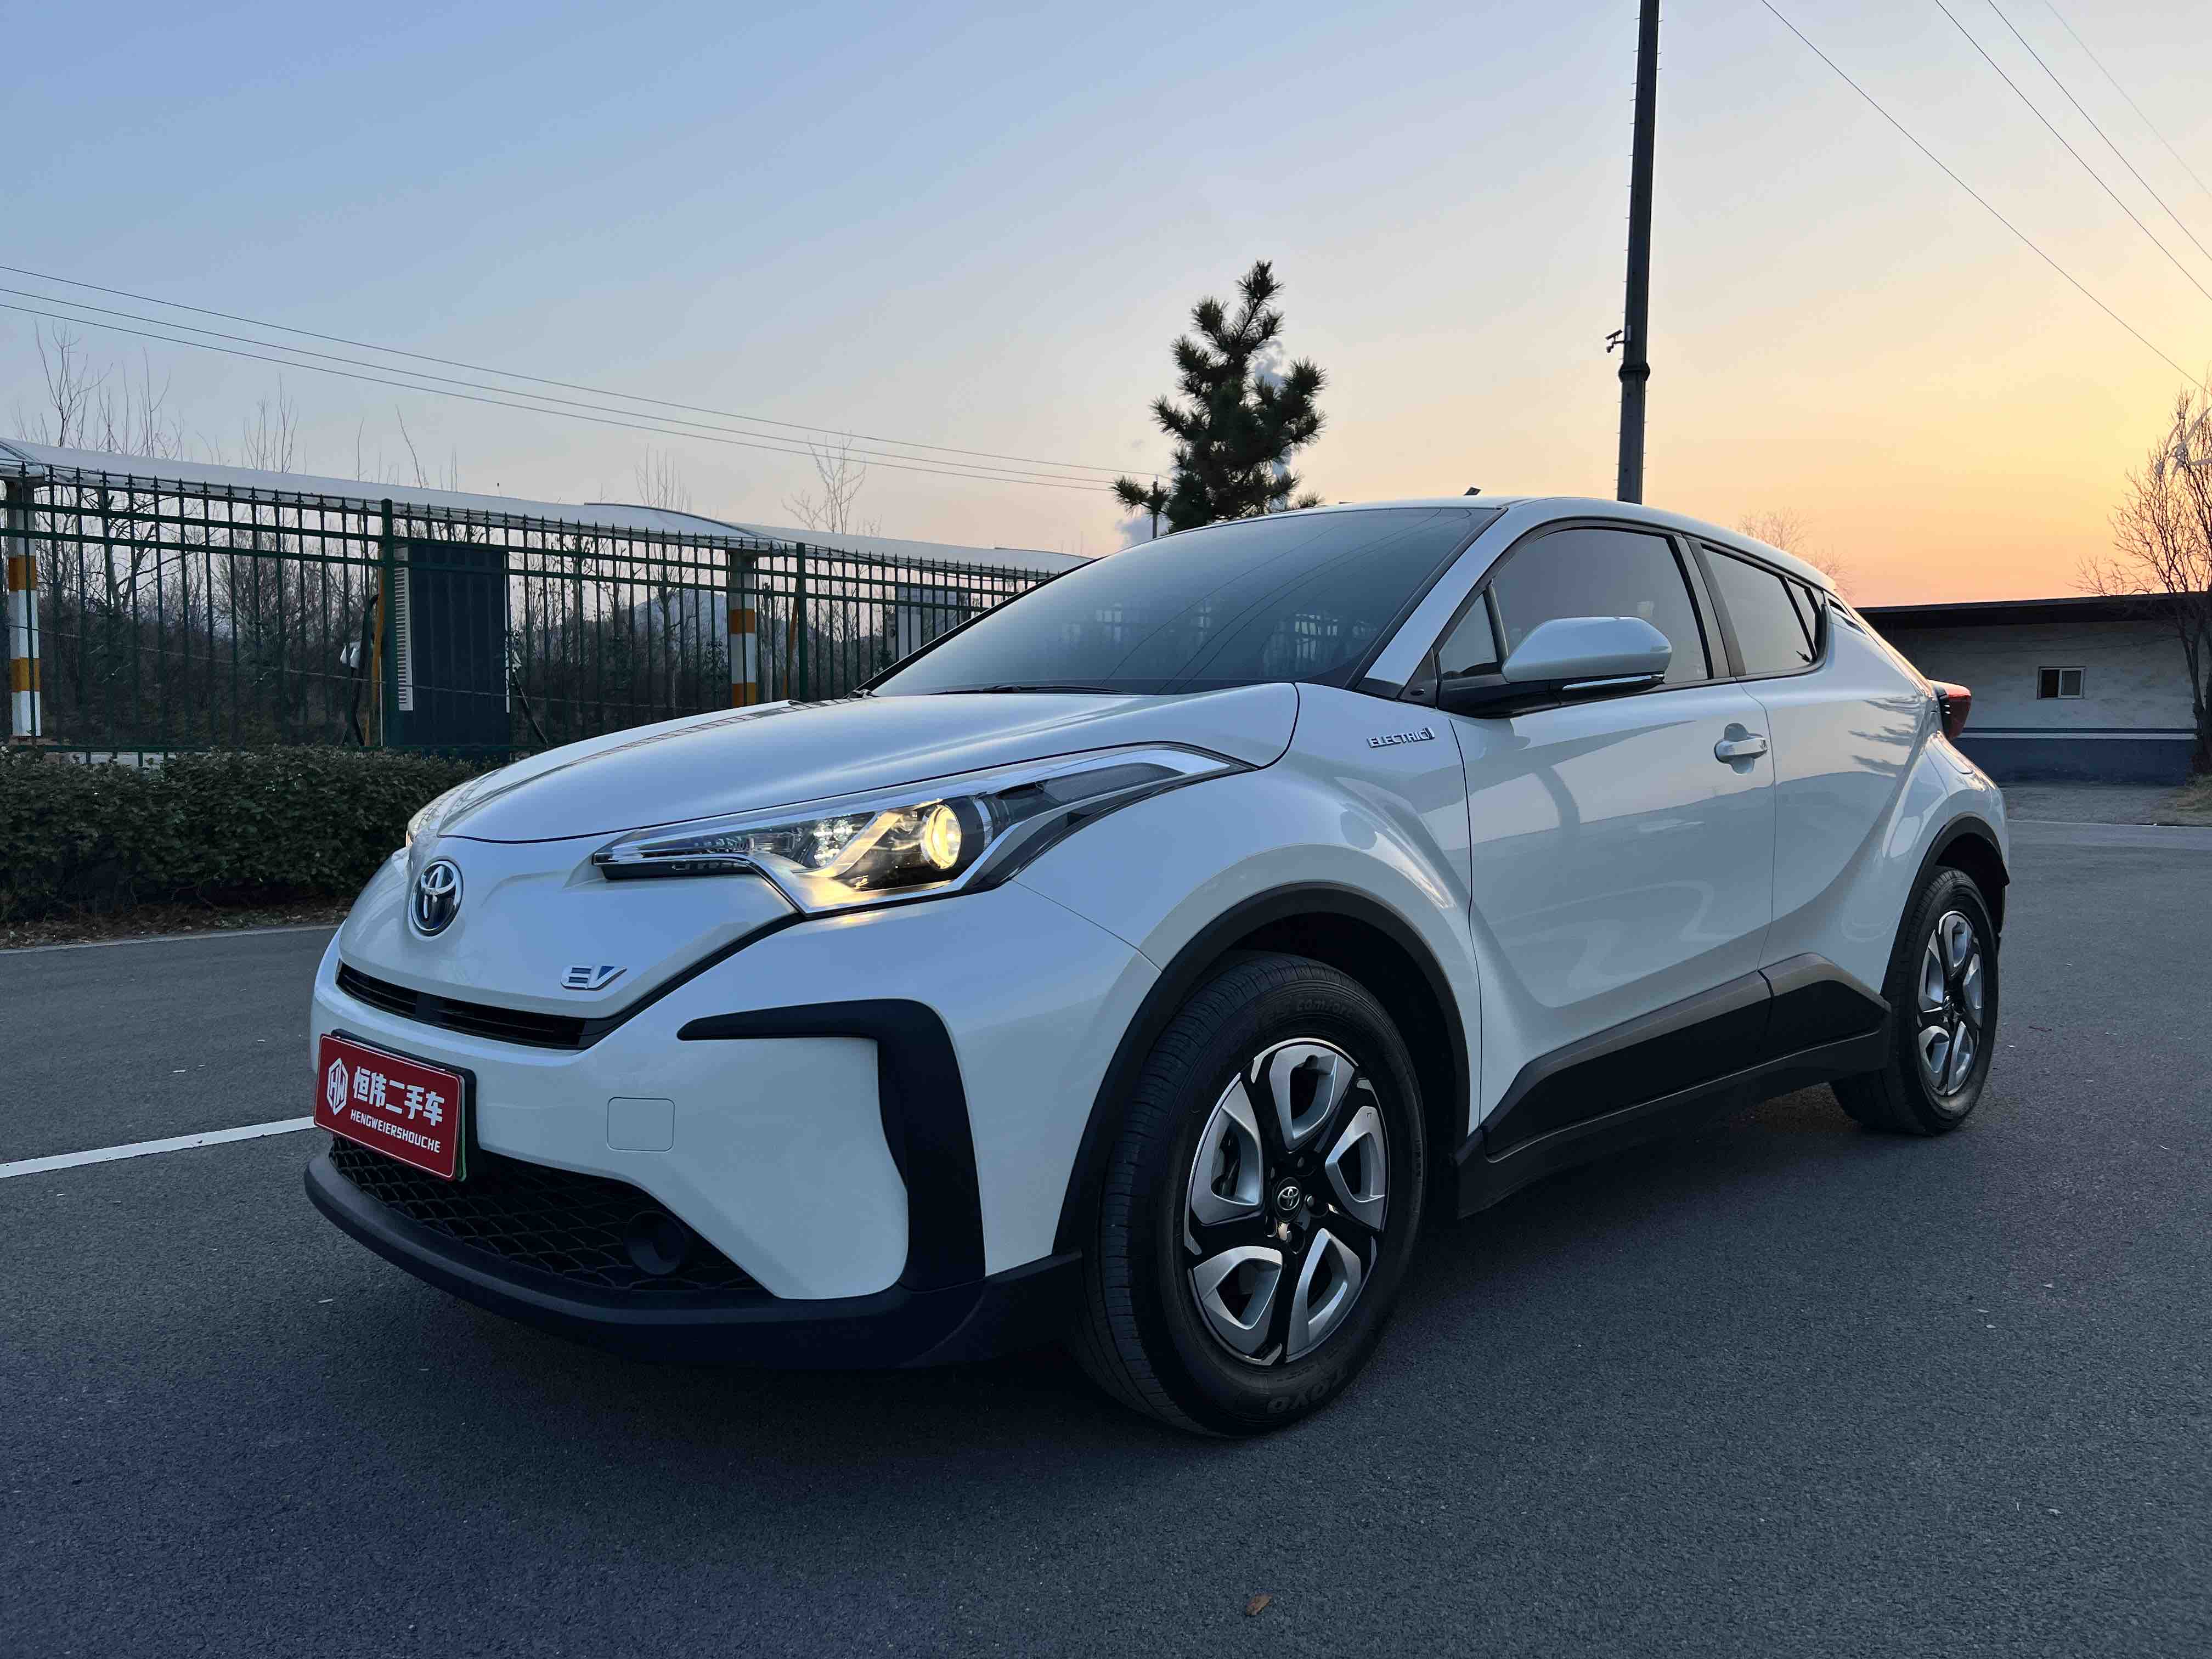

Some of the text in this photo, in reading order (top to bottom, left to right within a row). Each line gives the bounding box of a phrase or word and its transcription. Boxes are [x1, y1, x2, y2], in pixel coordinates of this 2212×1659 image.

[1367, 728, 1431, 748] ELECTRIC
[561, 966, 627, 990] EV
[353, 1066, 445, 1127] 恒伟二手车
[350, 1109, 441, 1153] HENGWEIERSHOUCHE
